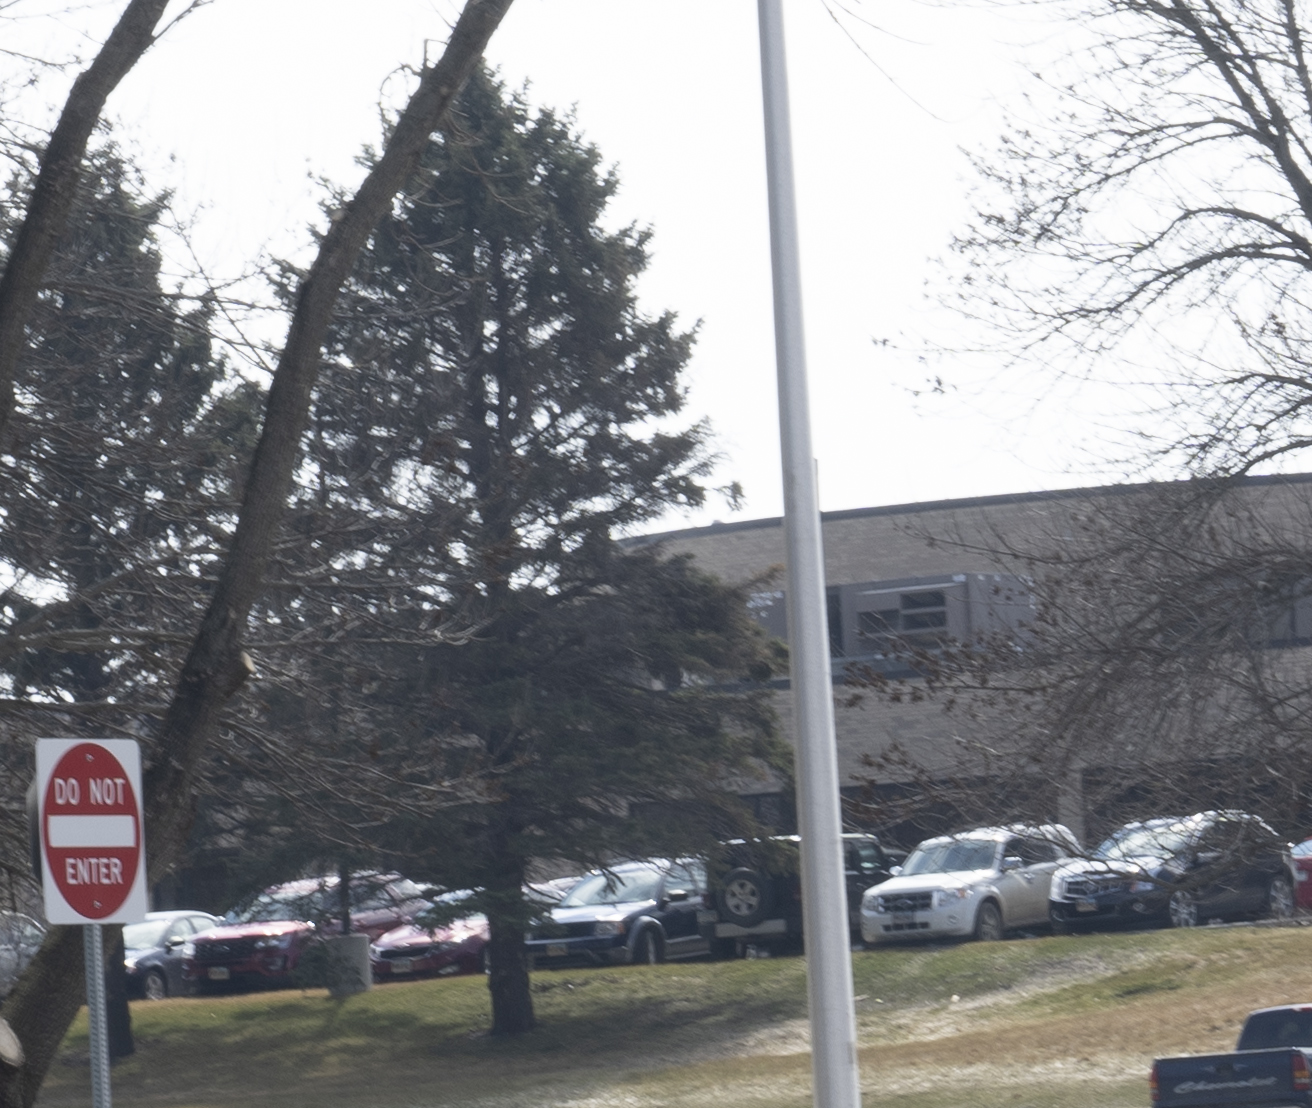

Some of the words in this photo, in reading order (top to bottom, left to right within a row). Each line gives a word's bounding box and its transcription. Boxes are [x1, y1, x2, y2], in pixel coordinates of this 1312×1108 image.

[54, 778, 80, 805] DO
[89, 778, 126, 806] NOT
[65, 857, 123, 885] ENTER
